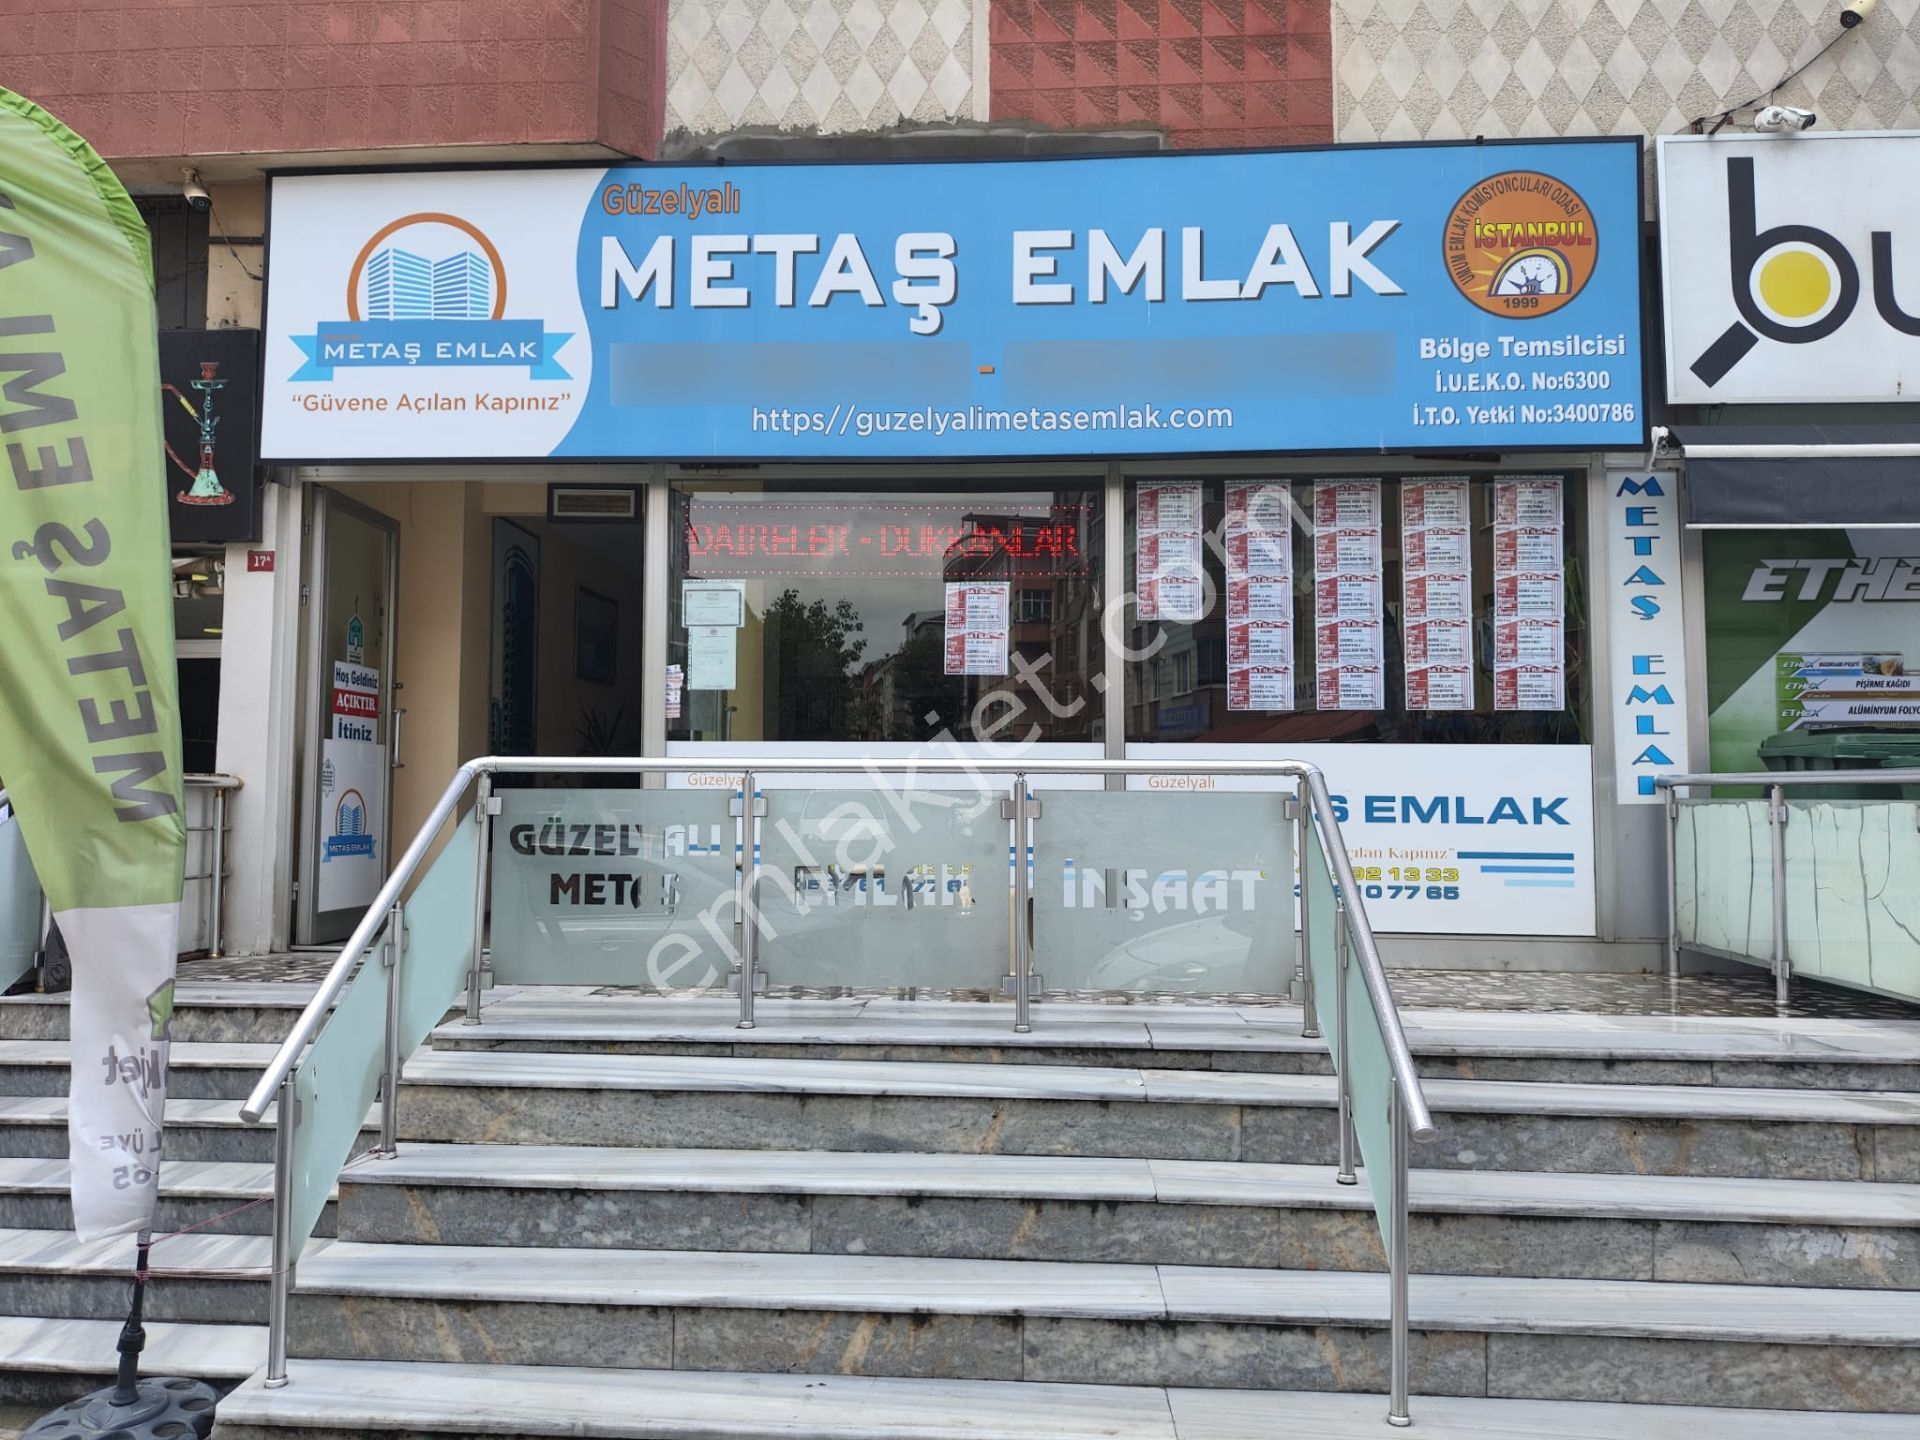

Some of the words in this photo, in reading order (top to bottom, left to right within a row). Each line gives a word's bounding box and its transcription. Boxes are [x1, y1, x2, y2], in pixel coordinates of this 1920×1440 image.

[602, 182, 740, 219] Güzelyalı
[1551, 187, 1582, 217] ODASI
[1474, 218, 1591, 248] İSTANBUL
[601, 232, 958, 335] METAŞ
[1013, 220, 1407, 304] EMLAK
[1503, 297, 1540, 309] 1999
[324, 342, 421, 364] METAŞ
[436, 341, 537, 359] EMLAK
[1420, 337, 1491, 363] Bölge
[1498, 334, 1626, 358] Temsilcisi
[1435, 370, 1526, 393] İ.U.E.K.O.
[1532, 370, 1611, 391] No:6300
[396, 392, 466, 414] Açılan
[1412, 403, 1462, 426] İ.T.O.
[1466, 405, 1515, 425] Yetki
[1521, 403, 1636, 425] No:3400786
[752, 403, 1234, 436] https//guzelyalimetasemlak.com
[335, 667, 350, 687] Hoş
[351, 670, 378, 689] Geldiniz
[336, 692, 376, 712] AÇIKTIR
[1848, 704, 1897, 715] ALÜMİNYUM
[338, 717, 372, 742] İtiniz
[688, 773, 743, 787] Güzelya
[1148, 775, 1216, 791] Güzelyalı
[1364, 795, 1571, 825] EMLAK
[510, 817, 721, 859] GÜZELALI
[1388, 867, 1420, 881] 13
[1426, 867, 1459, 882] 33
[1387, 885, 1420, 899] 77
[1426, 886, 1460, 900] 65
